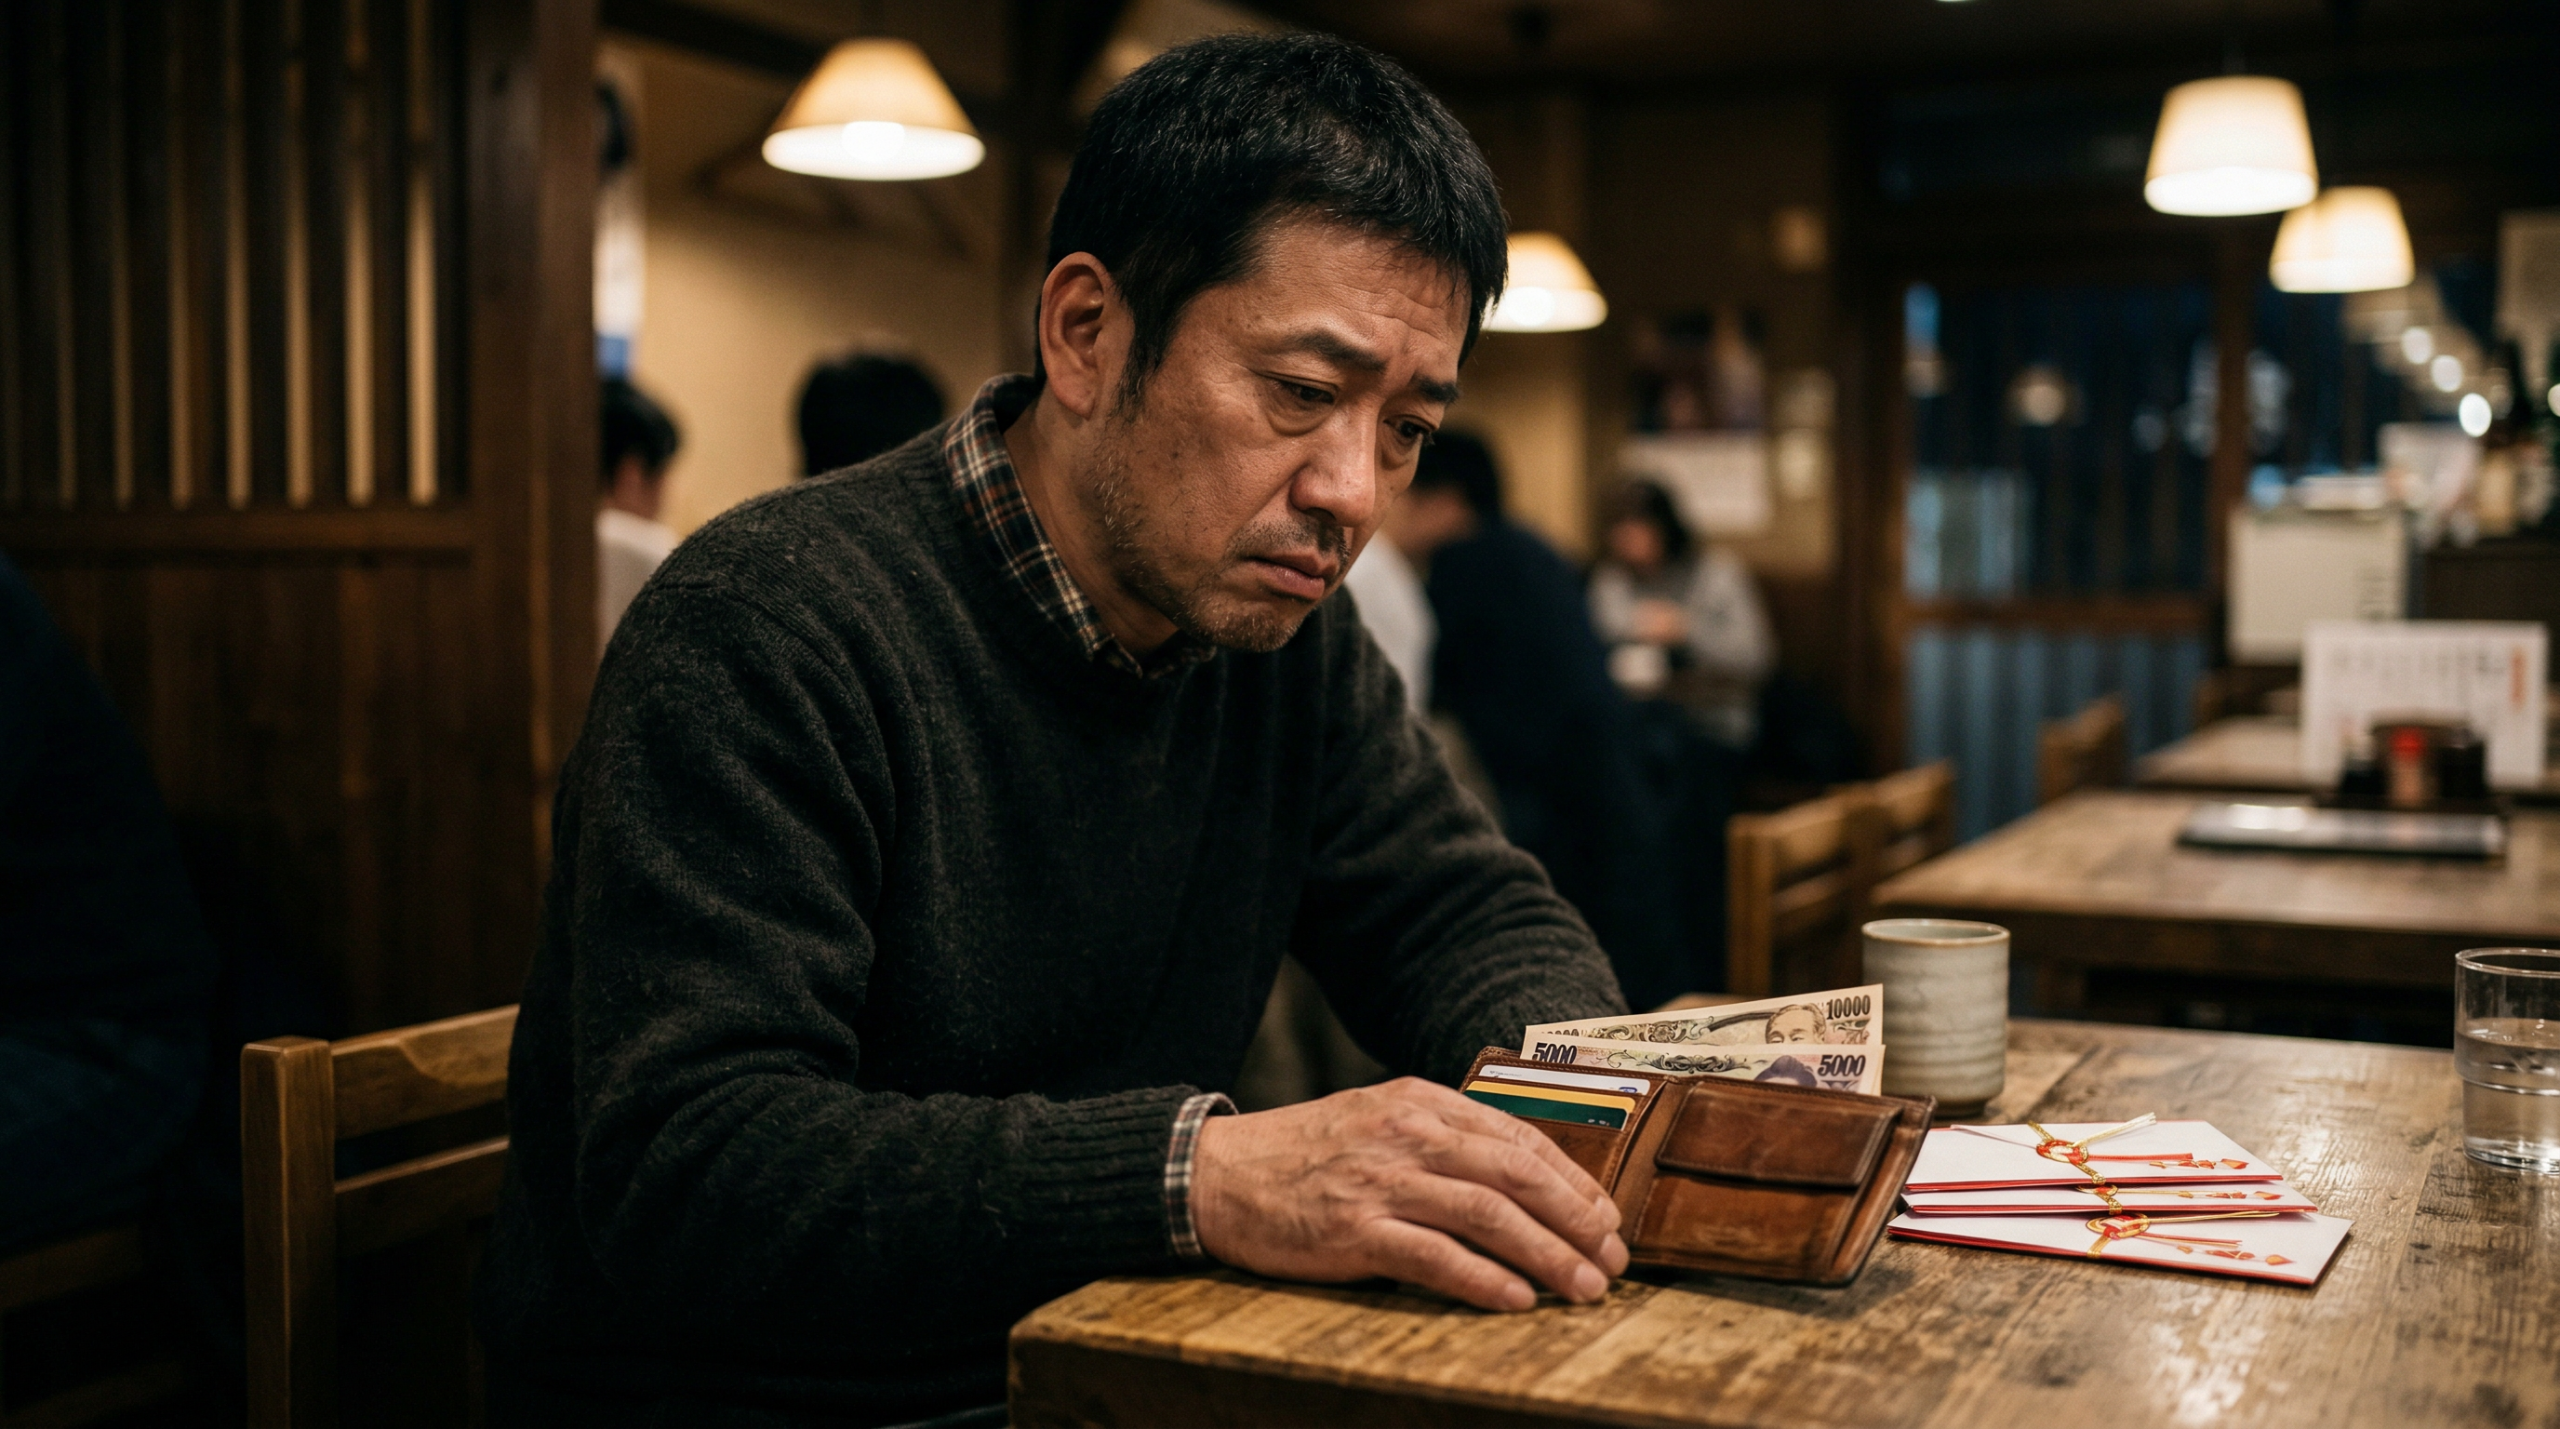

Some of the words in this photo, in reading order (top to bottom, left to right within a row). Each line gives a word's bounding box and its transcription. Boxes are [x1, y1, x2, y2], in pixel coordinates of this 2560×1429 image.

[1826, 994, 1871, 1020] 10000
[1531, 1041, 1578, 1065] 5000
[1817, 1053, 1867, 1077] 5000
